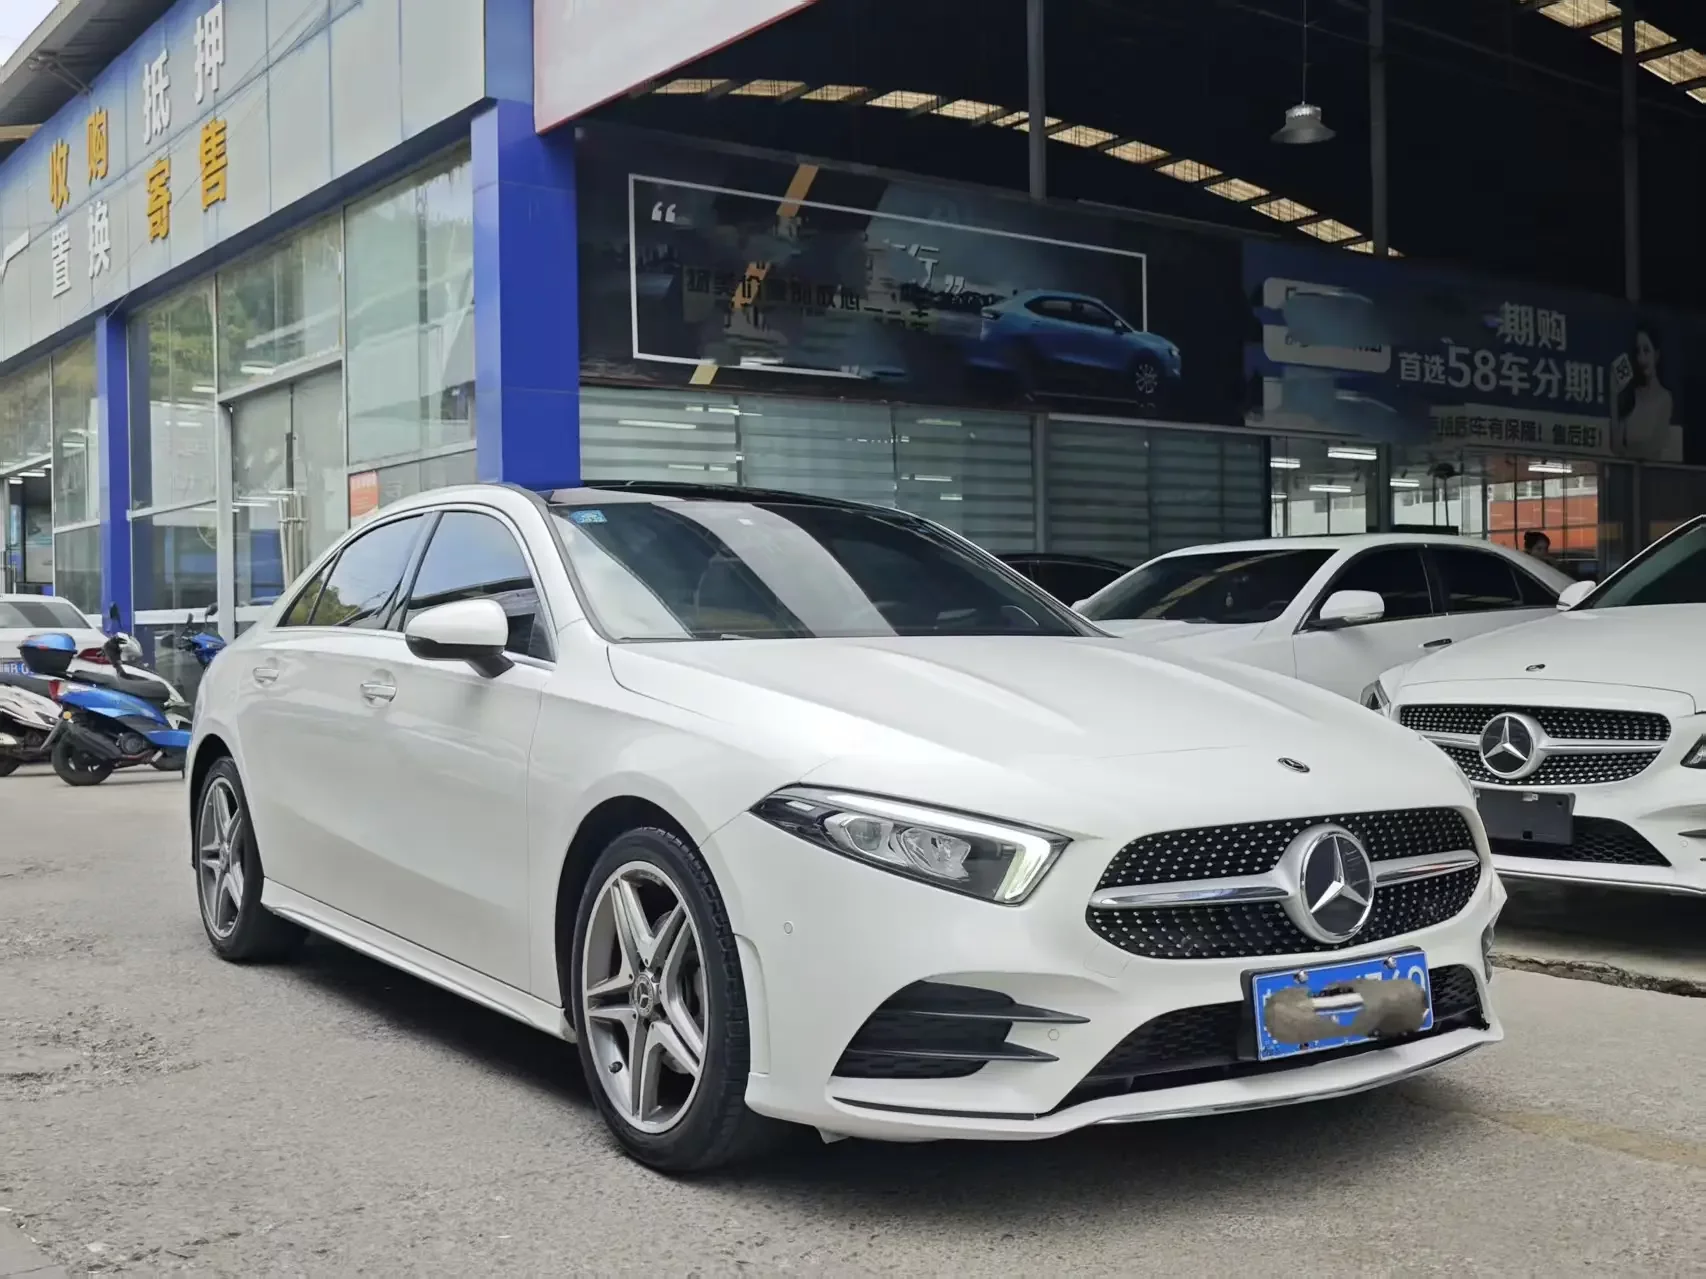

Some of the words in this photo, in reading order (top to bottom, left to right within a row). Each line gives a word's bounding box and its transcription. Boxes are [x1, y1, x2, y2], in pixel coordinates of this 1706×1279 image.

[50, 106, 110, 214] 收购
[143, 0, 226, 145] 抵押
[52, 200, 111, 299] 置换
[147, 117, 228, 243] 寄售
